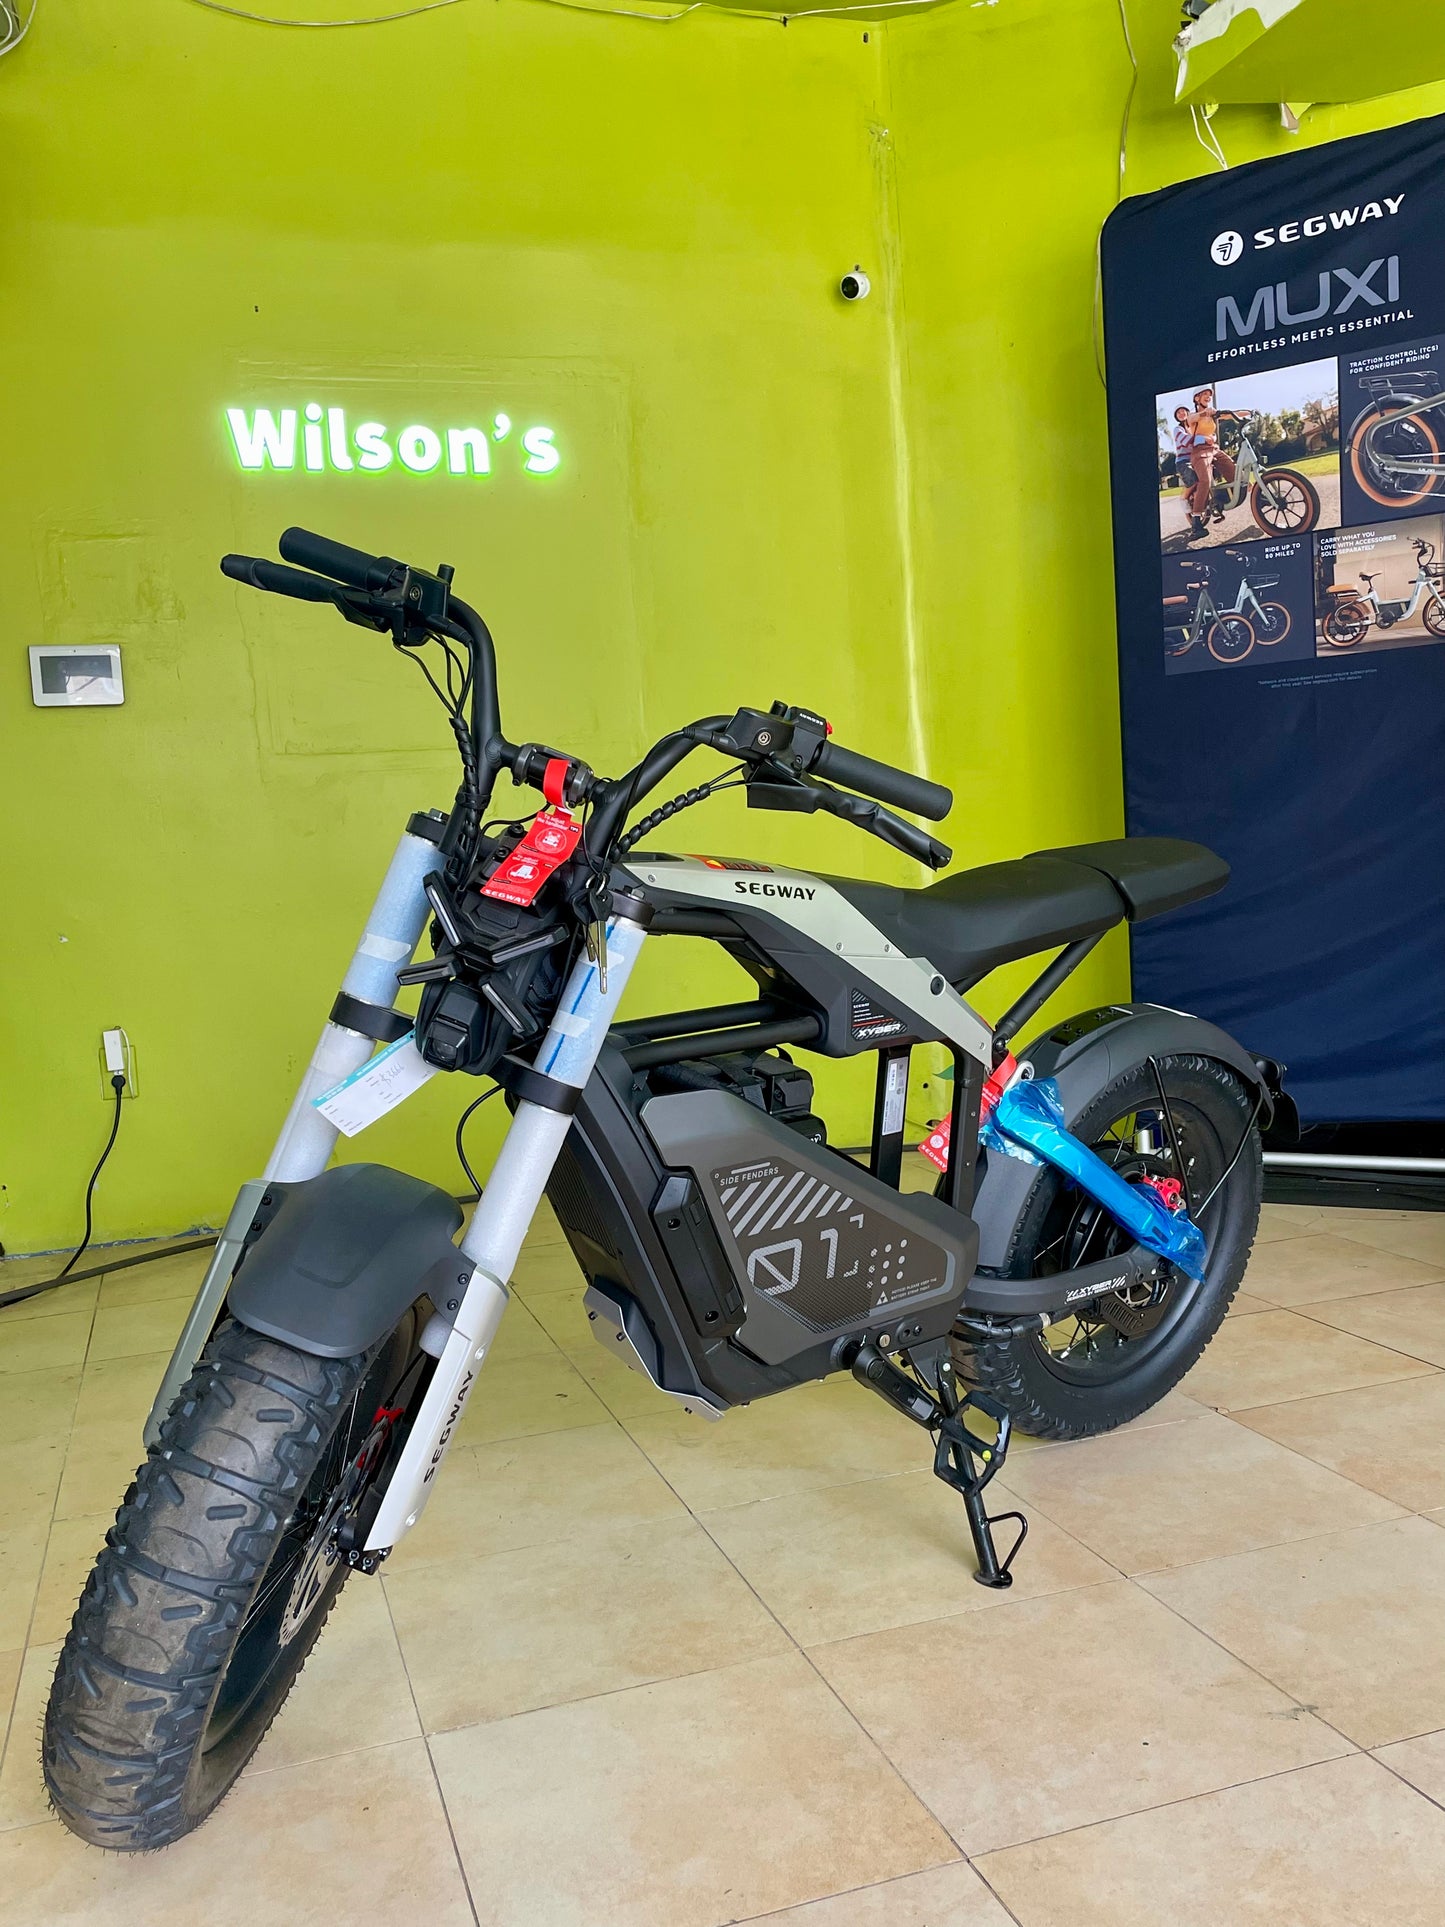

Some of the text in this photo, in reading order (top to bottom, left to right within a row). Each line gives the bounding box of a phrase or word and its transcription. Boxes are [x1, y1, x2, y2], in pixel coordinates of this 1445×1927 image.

[1254, 194, 1405, 249] SEGWAY
[1216, 255, 1400, 341] MUXI
[1207, 309, 1414, 363] EFFORTLESS MEETS ESSENTIAL
[1349, 356, 1383, 368] TRACTION
[1384, 349, 1418, 361] CONTROL
[1349, 353, 1430, 375] FOR CONFIDENT RIDING
[225, 402, 561, 475] Wilson's
[1264, 545, 1280, 553] RIDE
[1281, 544, 1291, 552] UP
[1320, 536, 1340, 545] CARRY
[1341, 533, 1360, 542] WHAT
[1337, 541, 1354, 549] WITH
[1354, 534, 1397, 546] ACCESSORIES
[1275, 549, 1295, 558] MILES
[1320, 544, 1376, 558] SOLD SEPARATELY
[484, 889, 529, 904] SEGWAY
[734, 881, 816, 901] SEGWAY
[857, 1023, 901, 1038] XYBER
[922, 1144, 947, 1169] SEGWAY
[720, 1166, 779, 1186] SIDE FENDERS
[423, 1370, 474, 1483] SEGWAY
